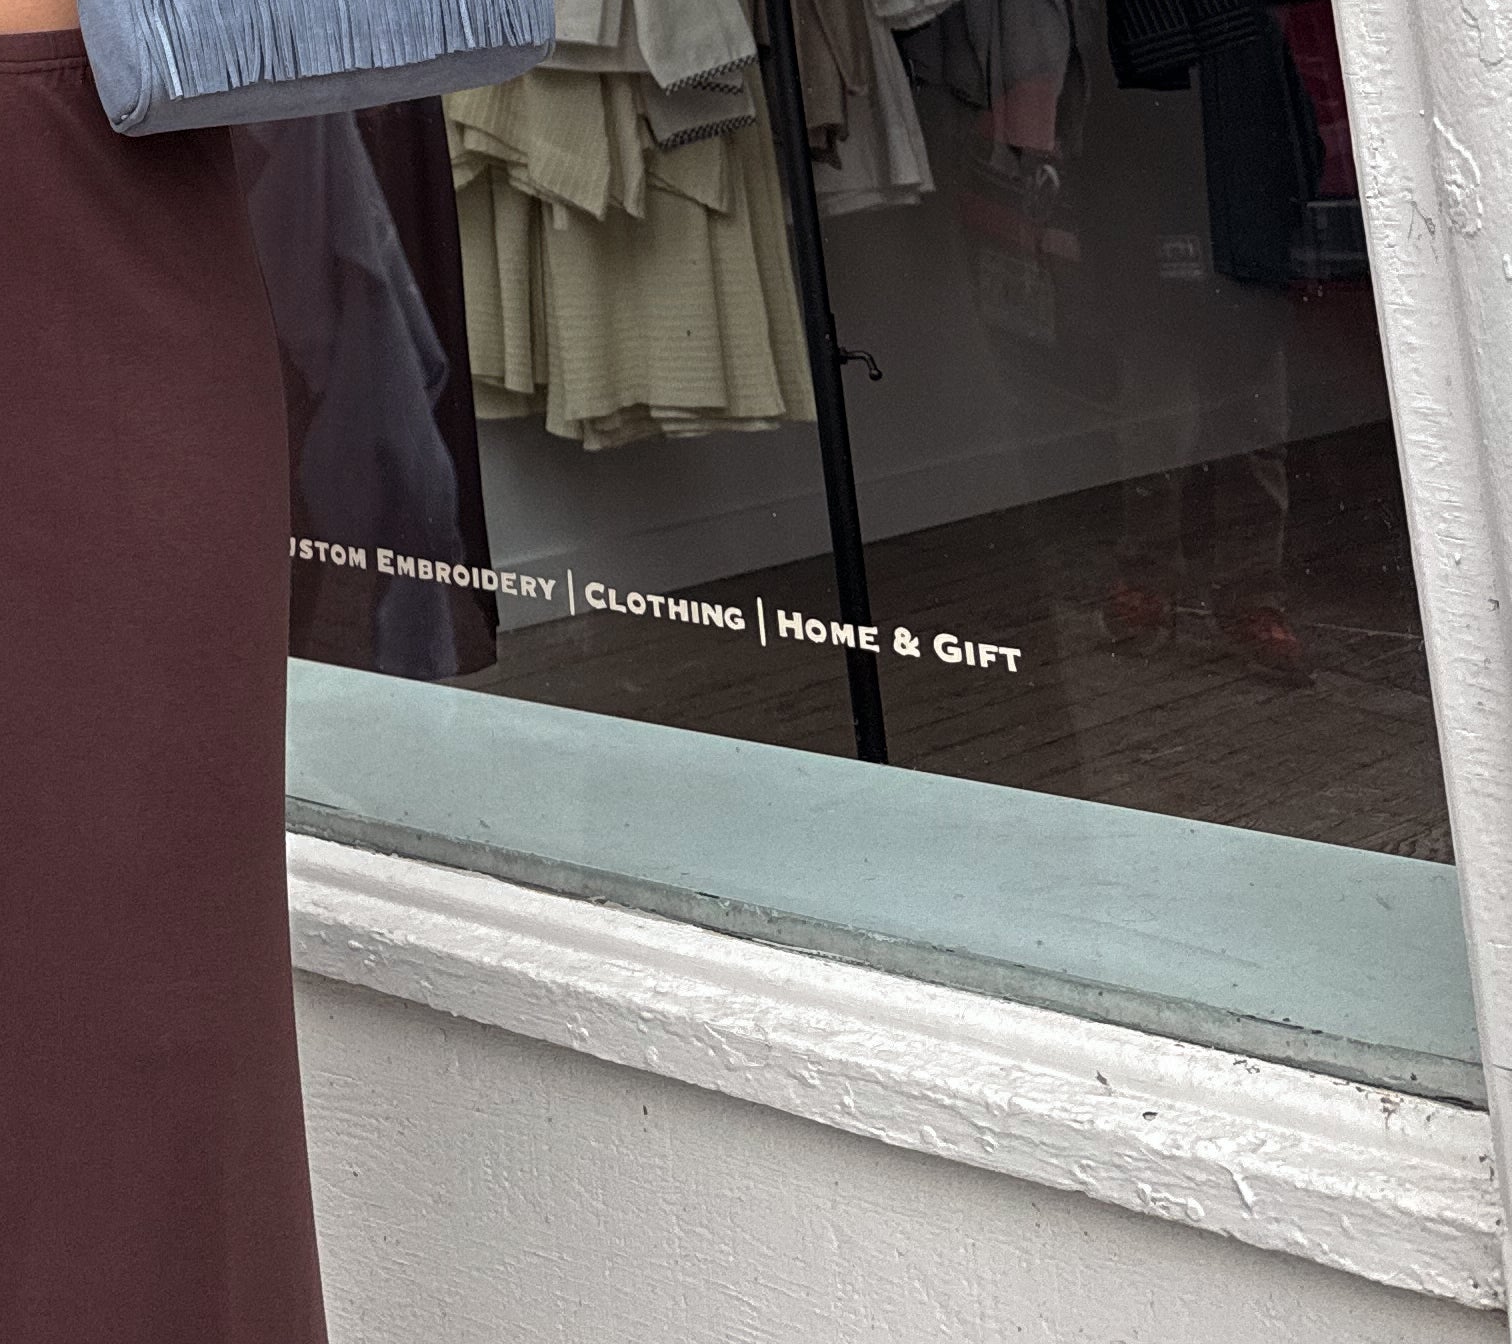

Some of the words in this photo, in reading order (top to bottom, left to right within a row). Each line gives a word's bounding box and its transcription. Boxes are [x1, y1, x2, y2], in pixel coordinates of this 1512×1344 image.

[377, 548, 557, 601] EMBROIDERY
[584, 581, 746, 631] CLOTHING
[776, 609, 880, 653] HOME
[893, 626, 921, 658] &
[933, 633, 1022, 673] GIFT
